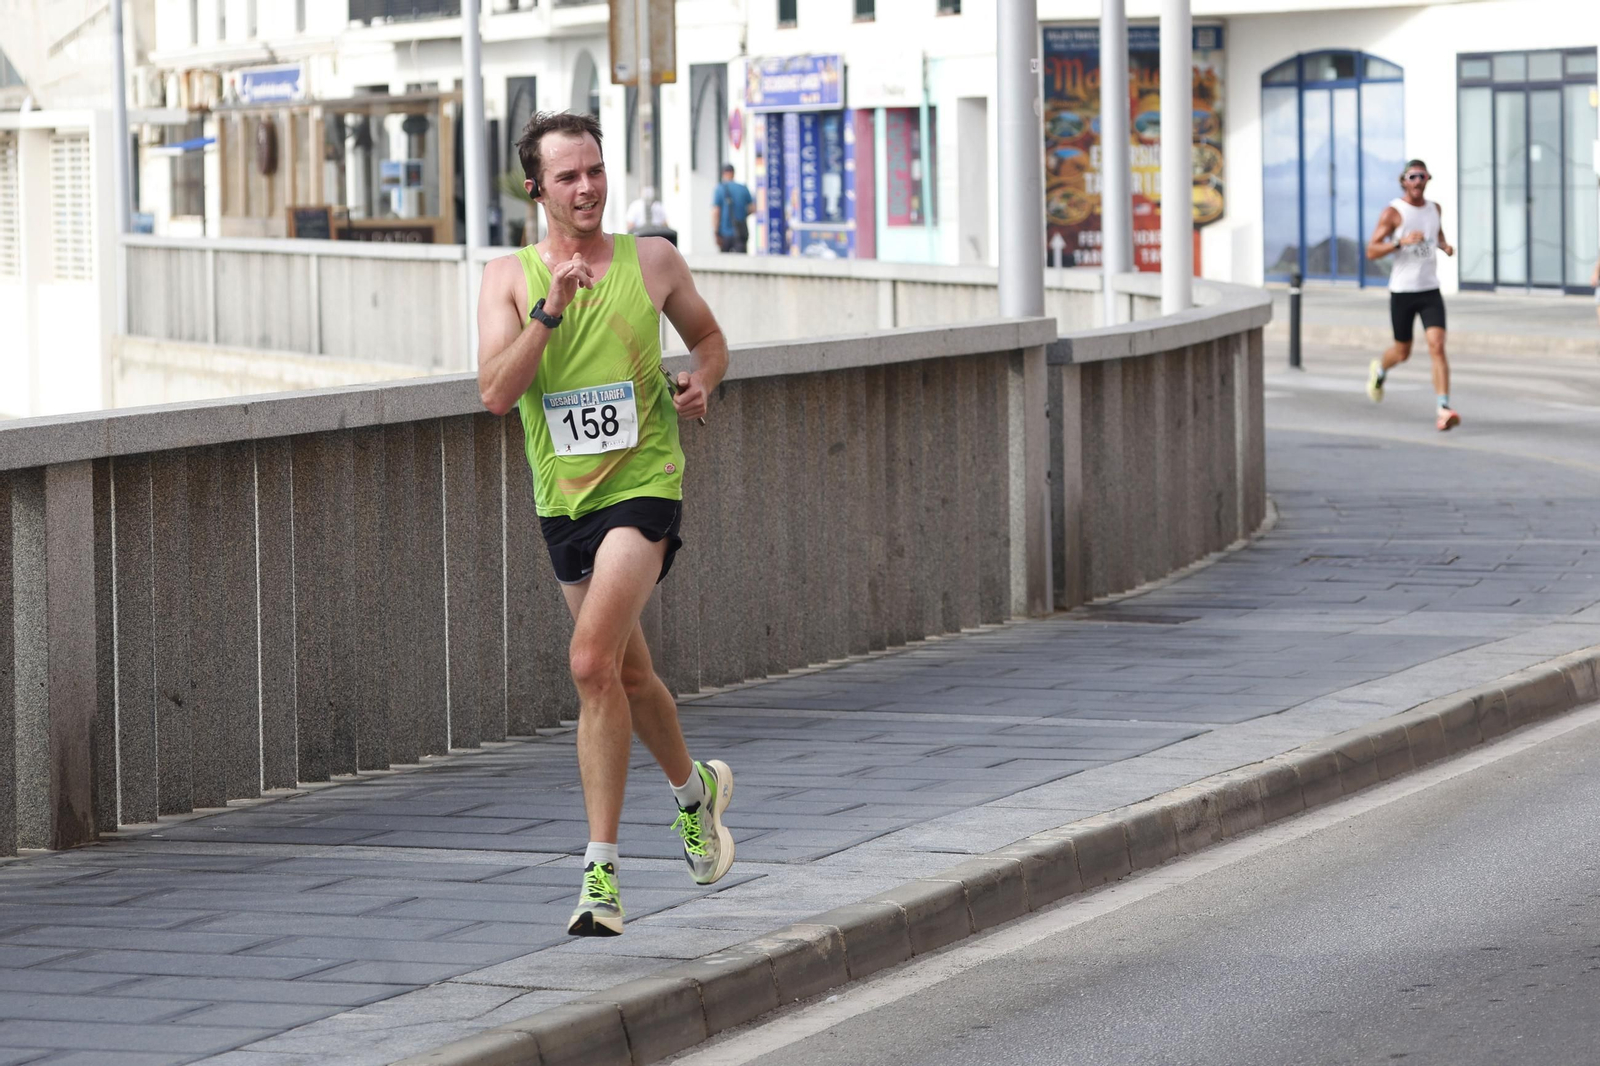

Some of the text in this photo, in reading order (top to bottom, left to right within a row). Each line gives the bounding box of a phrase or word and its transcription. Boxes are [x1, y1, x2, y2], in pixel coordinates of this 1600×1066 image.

[801, 115, 817, 221] TICKETS
[549, 388, 625, 408] DESAFÍO ELA TARIFA
[562, 404, 619, 441] 158
